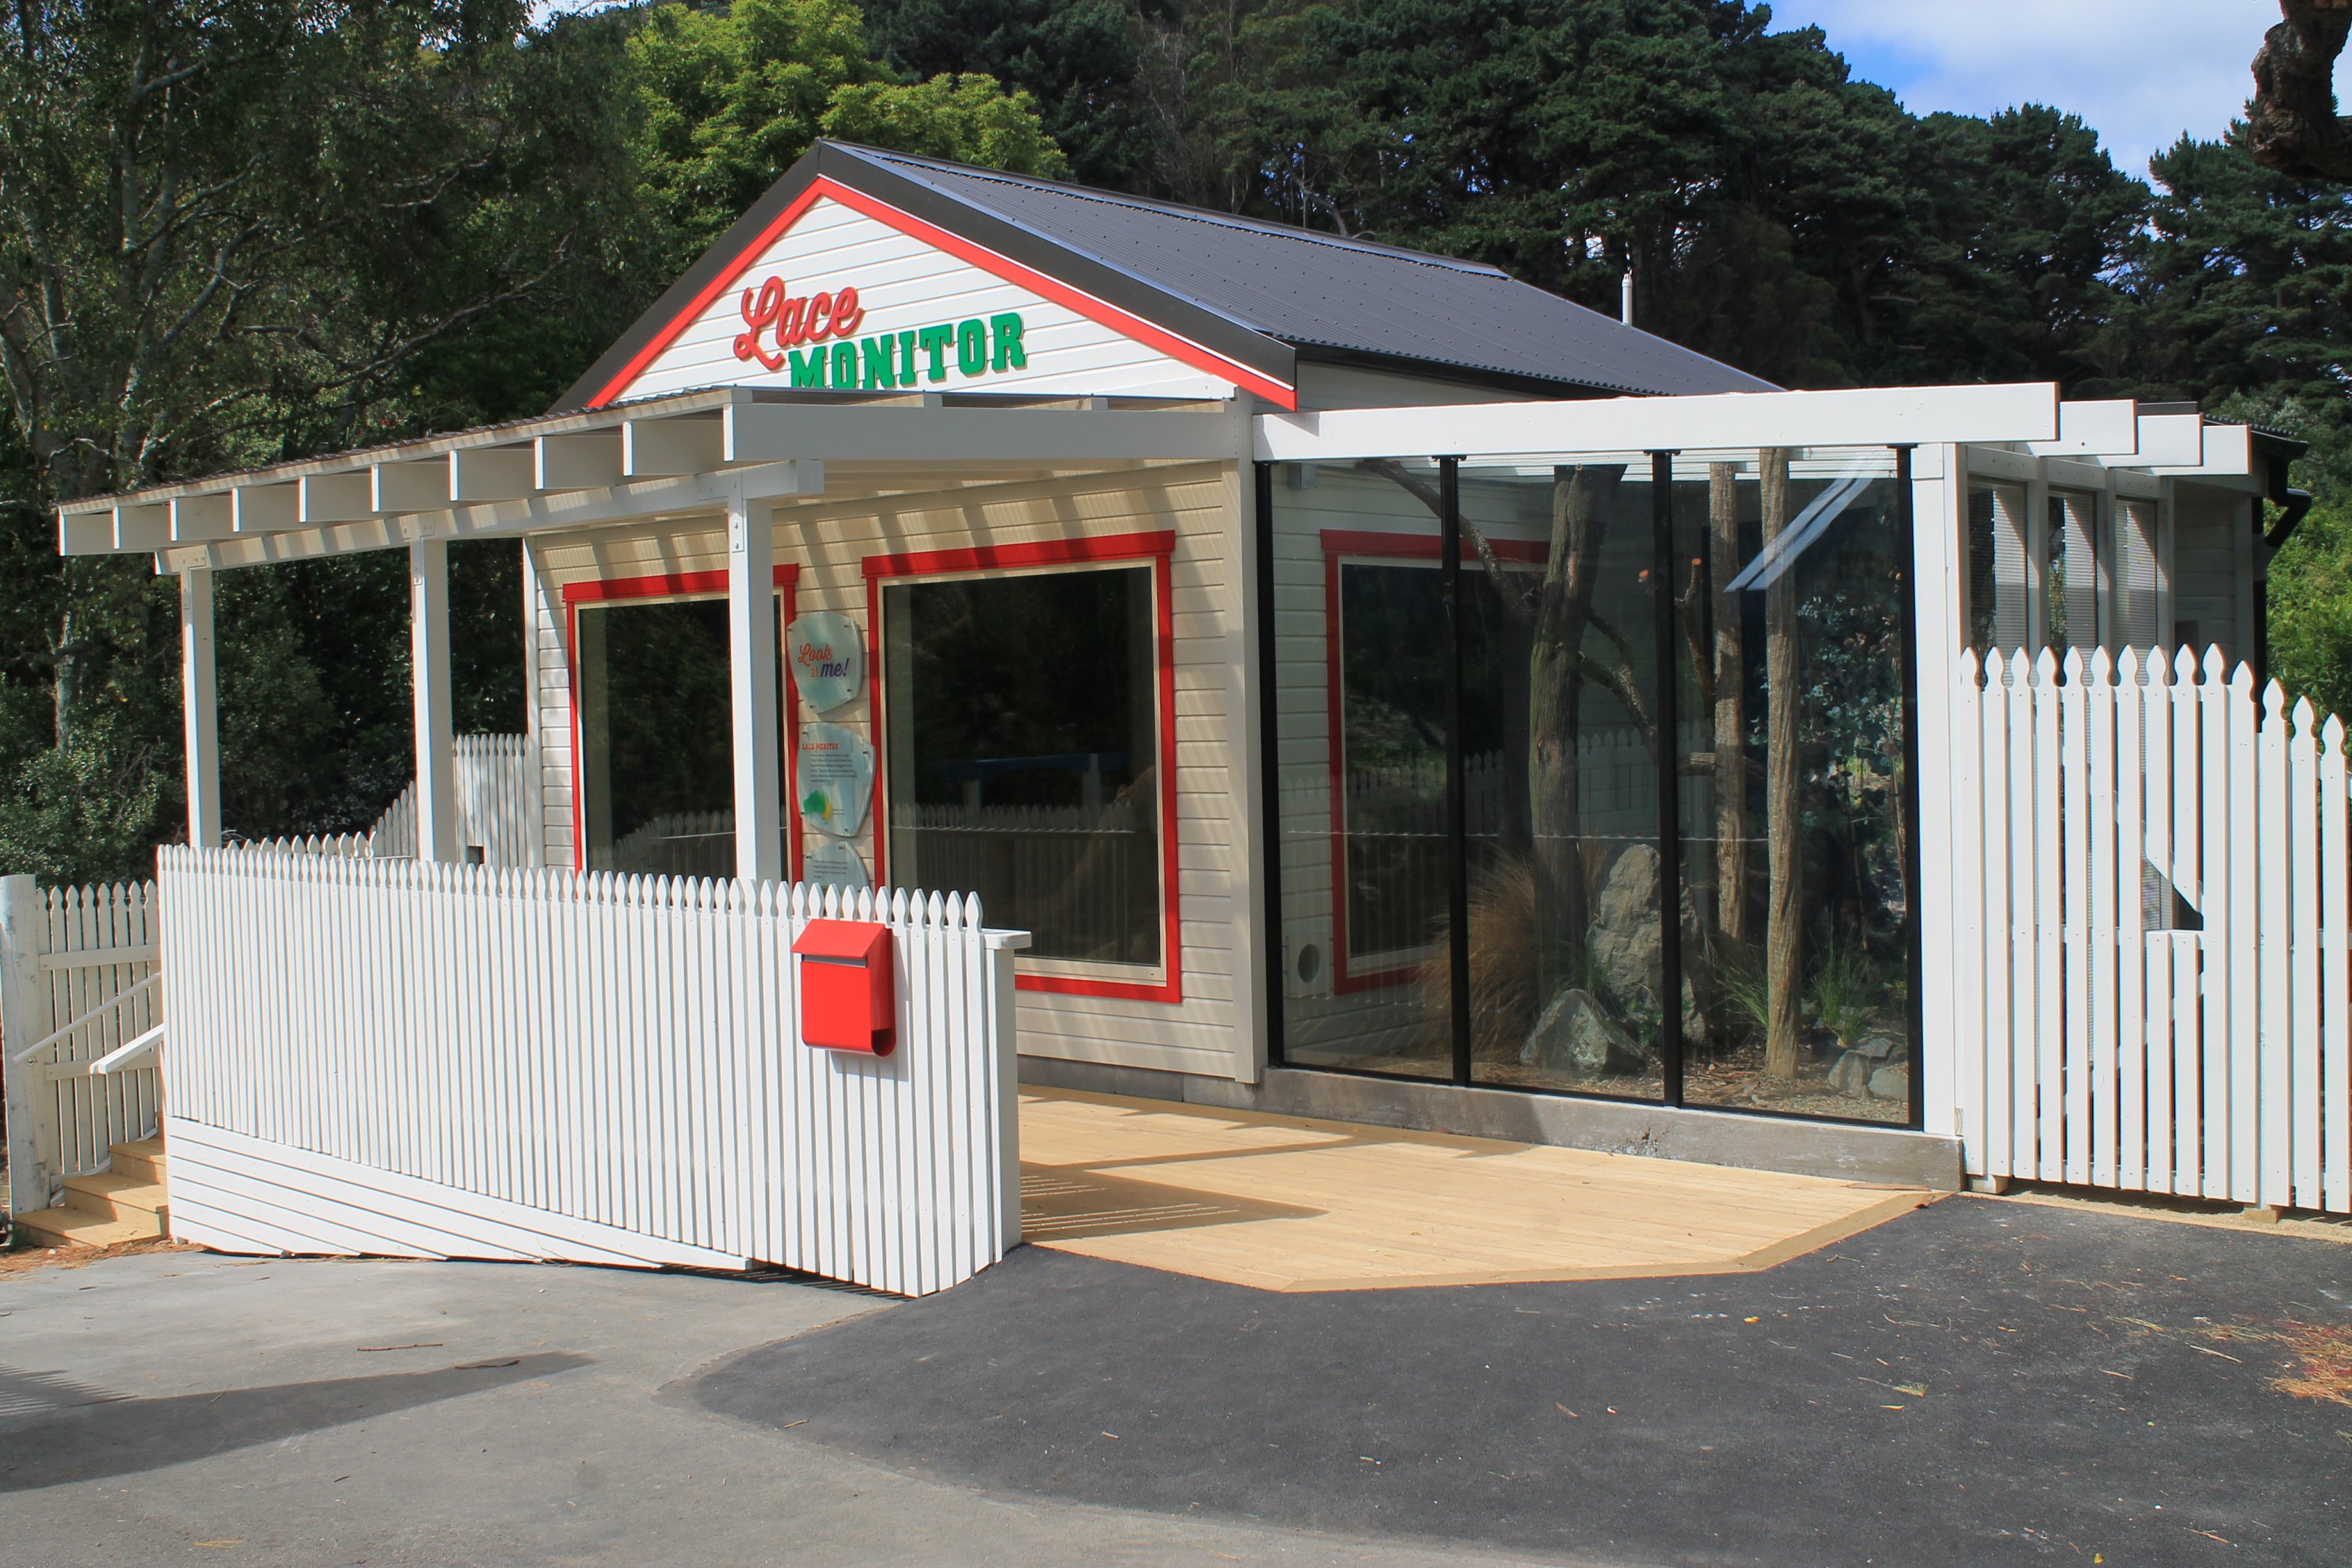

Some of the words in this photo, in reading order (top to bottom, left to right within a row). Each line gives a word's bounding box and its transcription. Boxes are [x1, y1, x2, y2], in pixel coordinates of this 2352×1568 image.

[733, 276, 863, 369] Lace
[788, 311, 1026, 390] MONITOR
[798, 642, 832, 667] Look
[820, 658, 849, 677] me!
